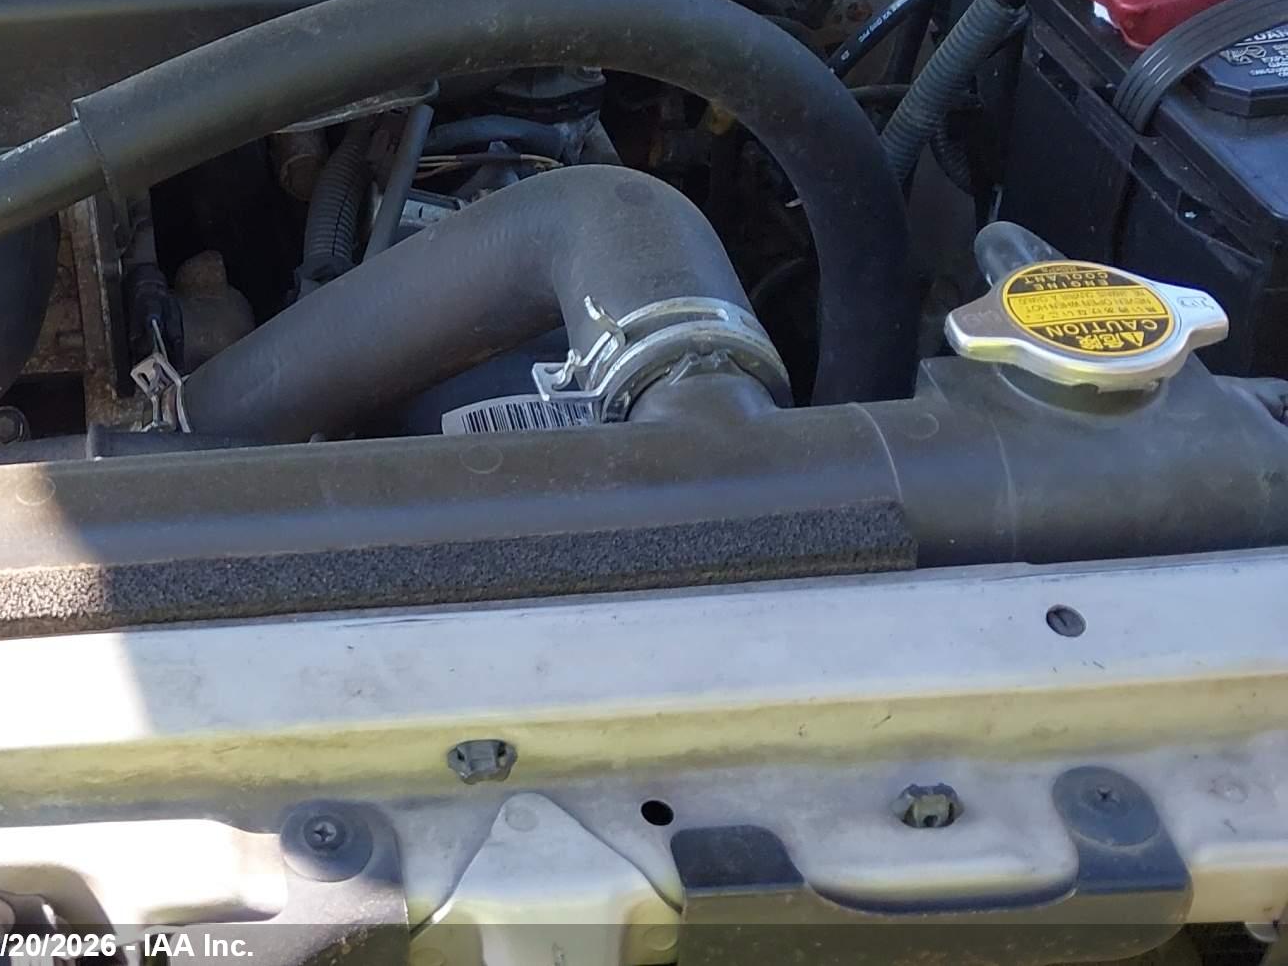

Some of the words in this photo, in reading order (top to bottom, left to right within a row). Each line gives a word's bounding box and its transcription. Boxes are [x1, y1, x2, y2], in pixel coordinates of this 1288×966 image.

[1024, 272, 1109, 284] COOLANT
[1033, 279, 1109, 291] ENGINE
[1045, 319, 1159, 338] CAUTION
[1075, 333, 1125, 351] 危険
